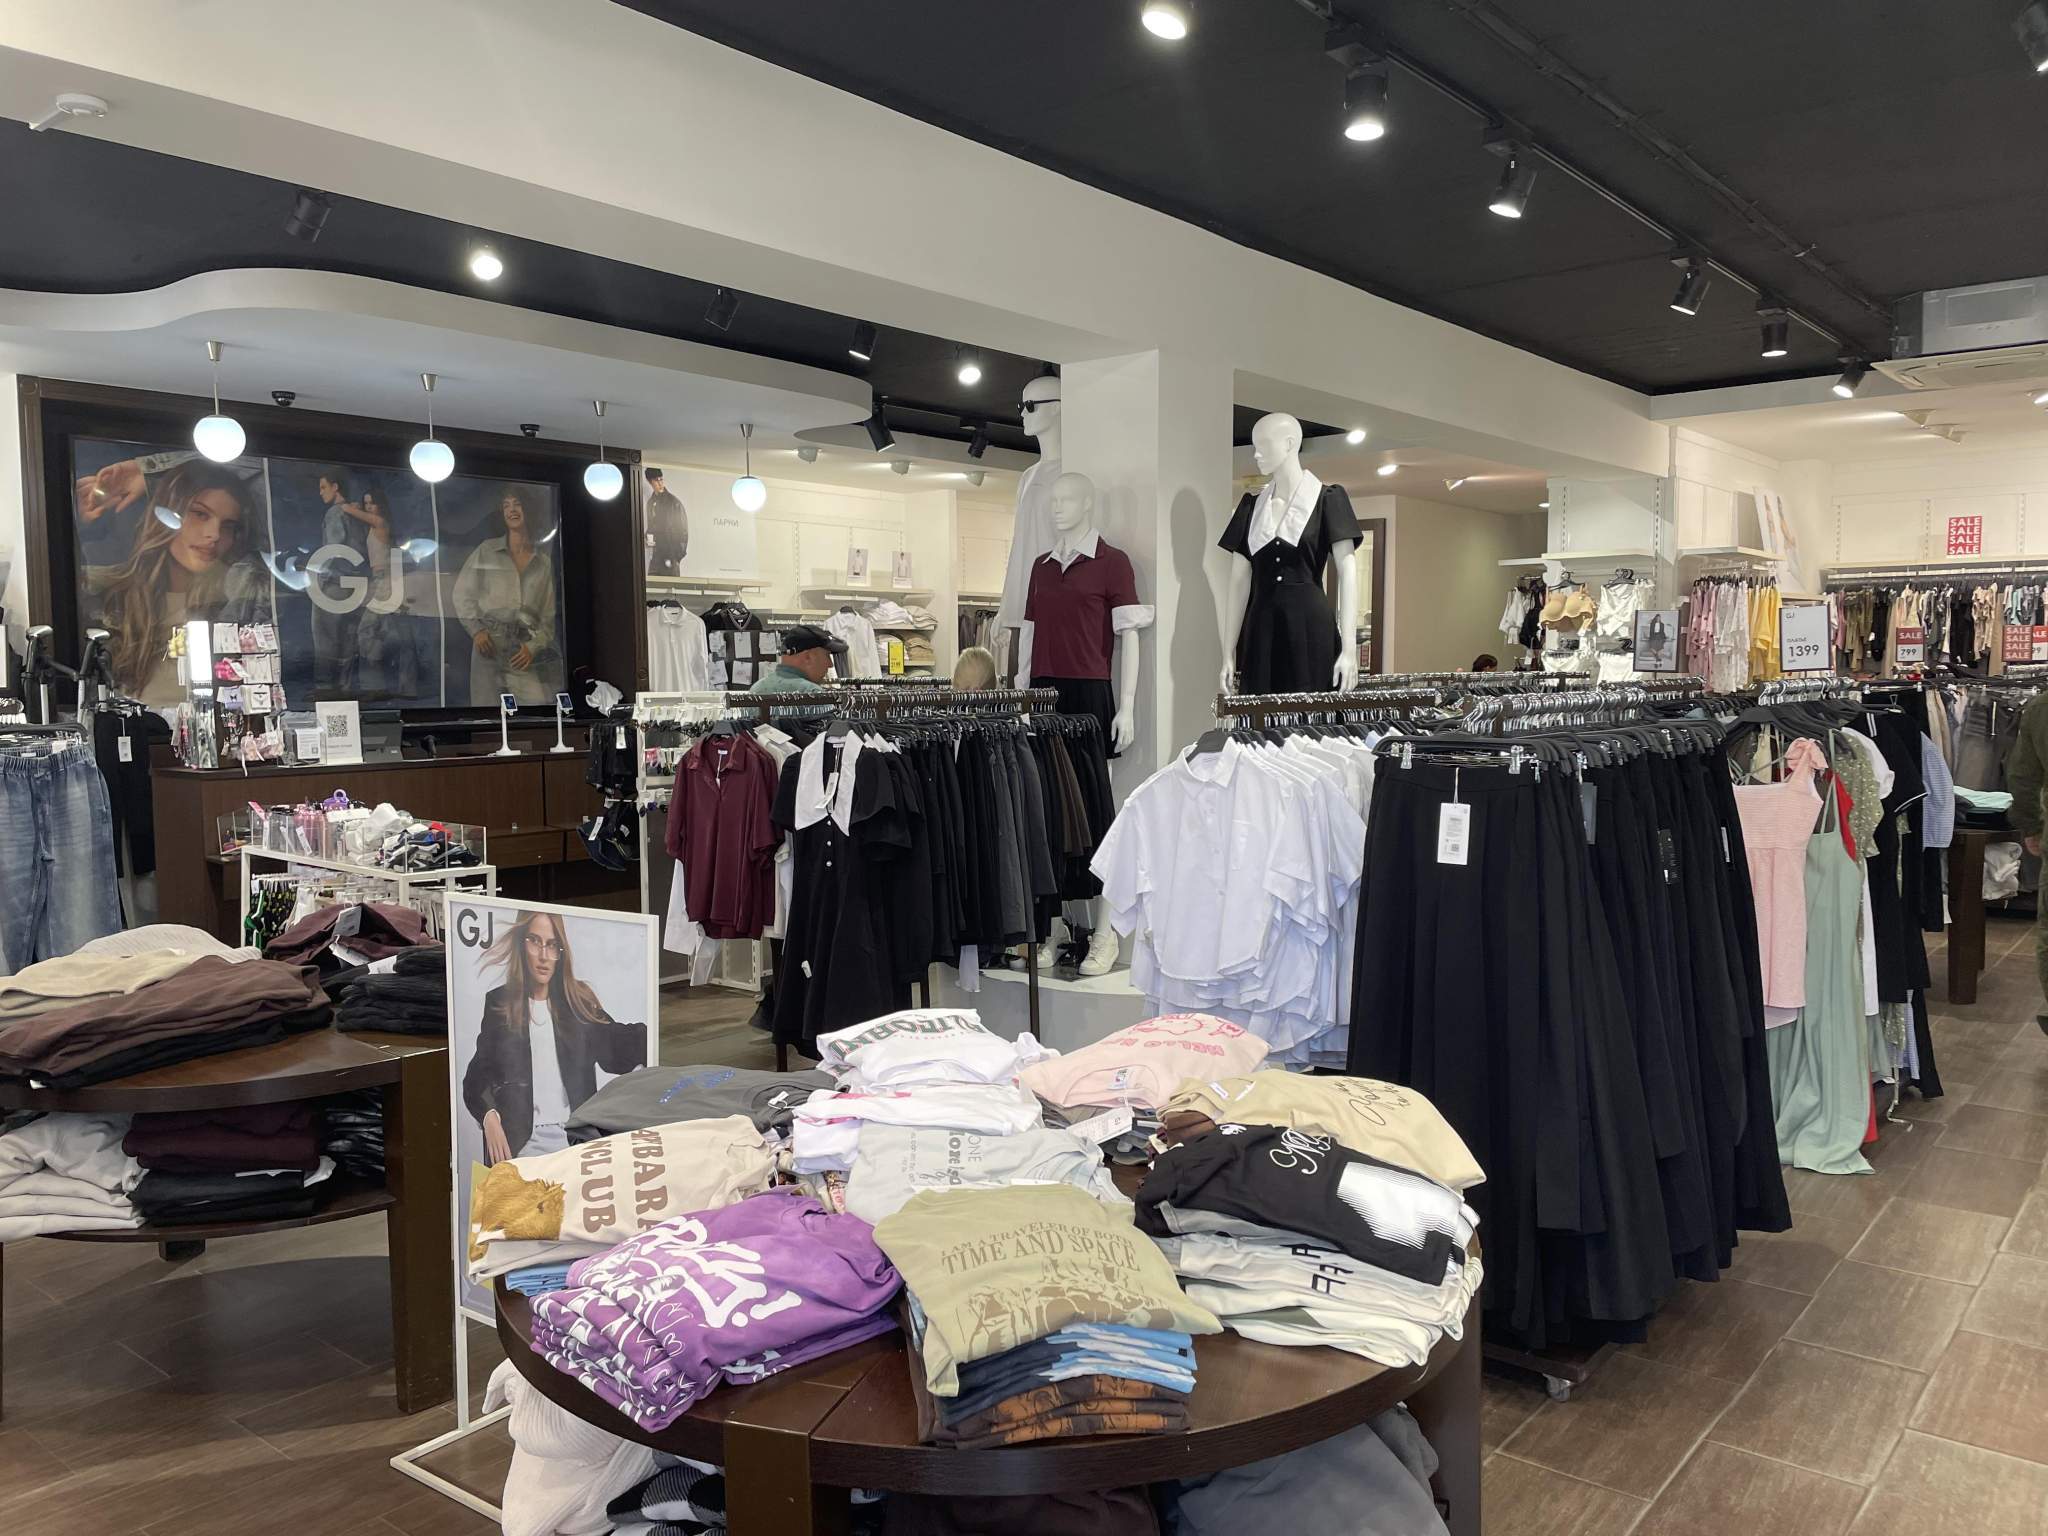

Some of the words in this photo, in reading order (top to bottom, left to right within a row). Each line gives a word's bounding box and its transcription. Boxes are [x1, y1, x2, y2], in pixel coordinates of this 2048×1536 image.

[1950, 517, 1981, 527] SALE
[1950, 526, 1980, 535] SALE
[1950, 535, 1980, 544] SALE
[1949, 545, 1979, 555] SALE
[306, 543, 404, 615] GJ
[1789, 644, 1820, 657] 1399
[2005, 642, 2030, 650] SALE
[1900, 648, 1917, 656] 799
[2005, 651, 2030, 659] SALE
[457, 908, 494, 949] GJ
[967, 1135, 982, 1162] ONE
[953, 1241, 972, 1251] AM
[977, 1238, 986, 1247] A
[989, 1221, 1069, 1242] TRAVELER
[1071, 1224, 1090, 1236] OF
[1094, 1230, 1134, 1248] BOTH
[941, 1241, 1007, 1275] TIME
[1014, 1230, 1064, 1258] AND
[1067, 1233, 1141, 1272] SPACE
